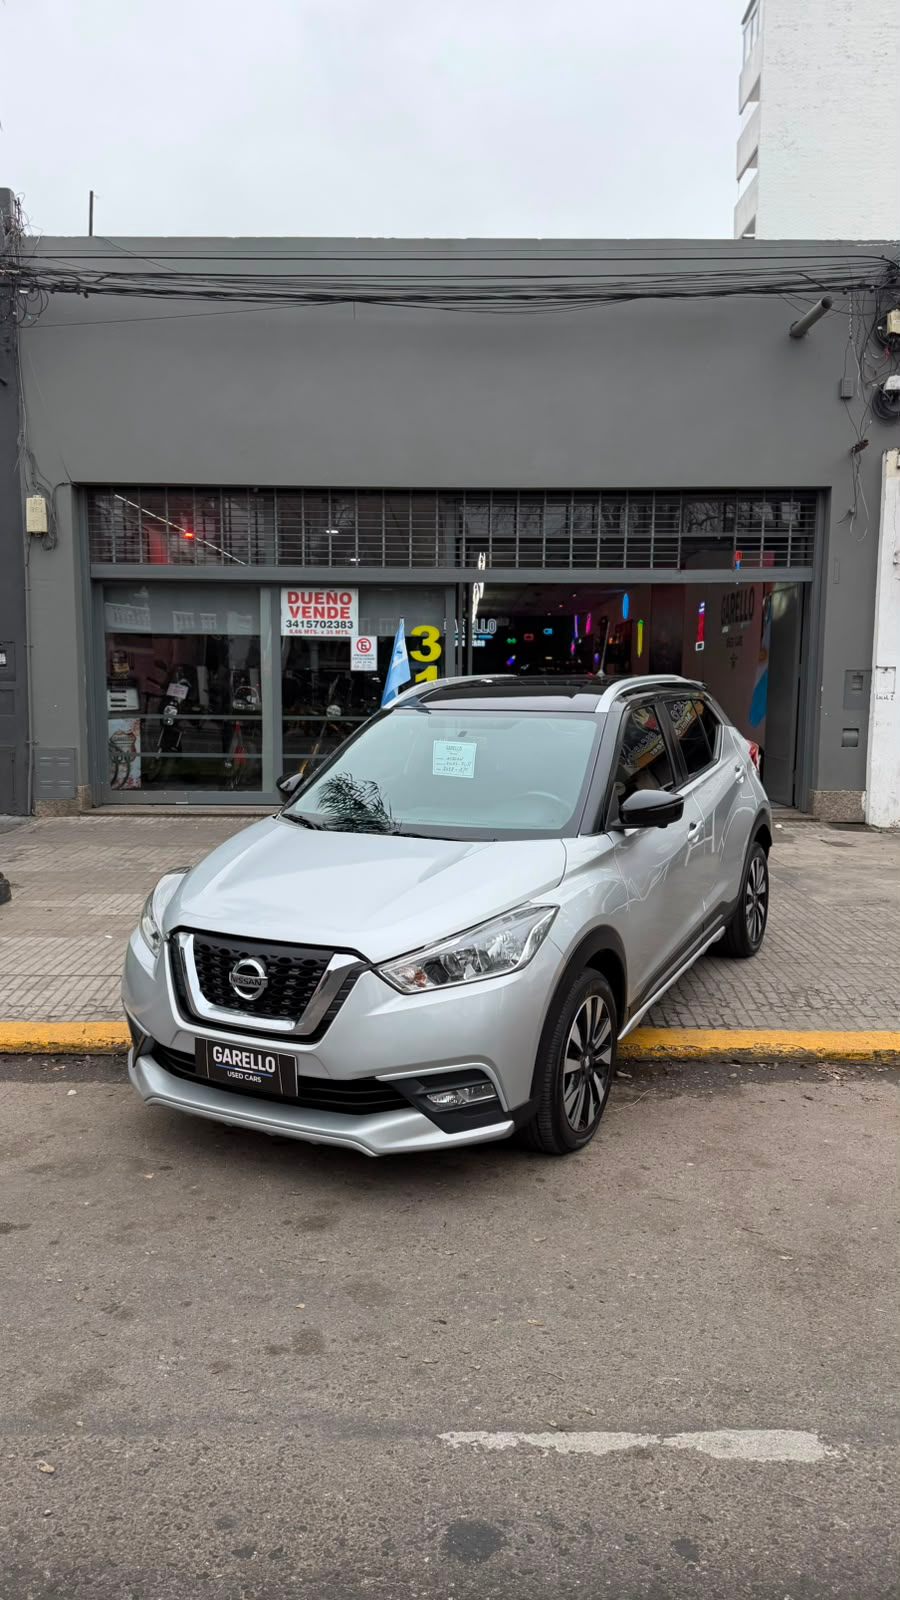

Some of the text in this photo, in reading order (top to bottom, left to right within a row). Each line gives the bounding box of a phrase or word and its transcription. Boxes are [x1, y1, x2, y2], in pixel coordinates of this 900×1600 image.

[287, 590, 352, 605] DUEÑO
[721, 586, 755, 625] GARELLO
[288, 606, 350, 619] VENDE
[286, 620, 354, 629] 3415702383
[232, 975, 262, 986] NISSAN
[213, 1046, 276, 1073] GARELLO
[227, 1070, 261, 1083] USED CARS
